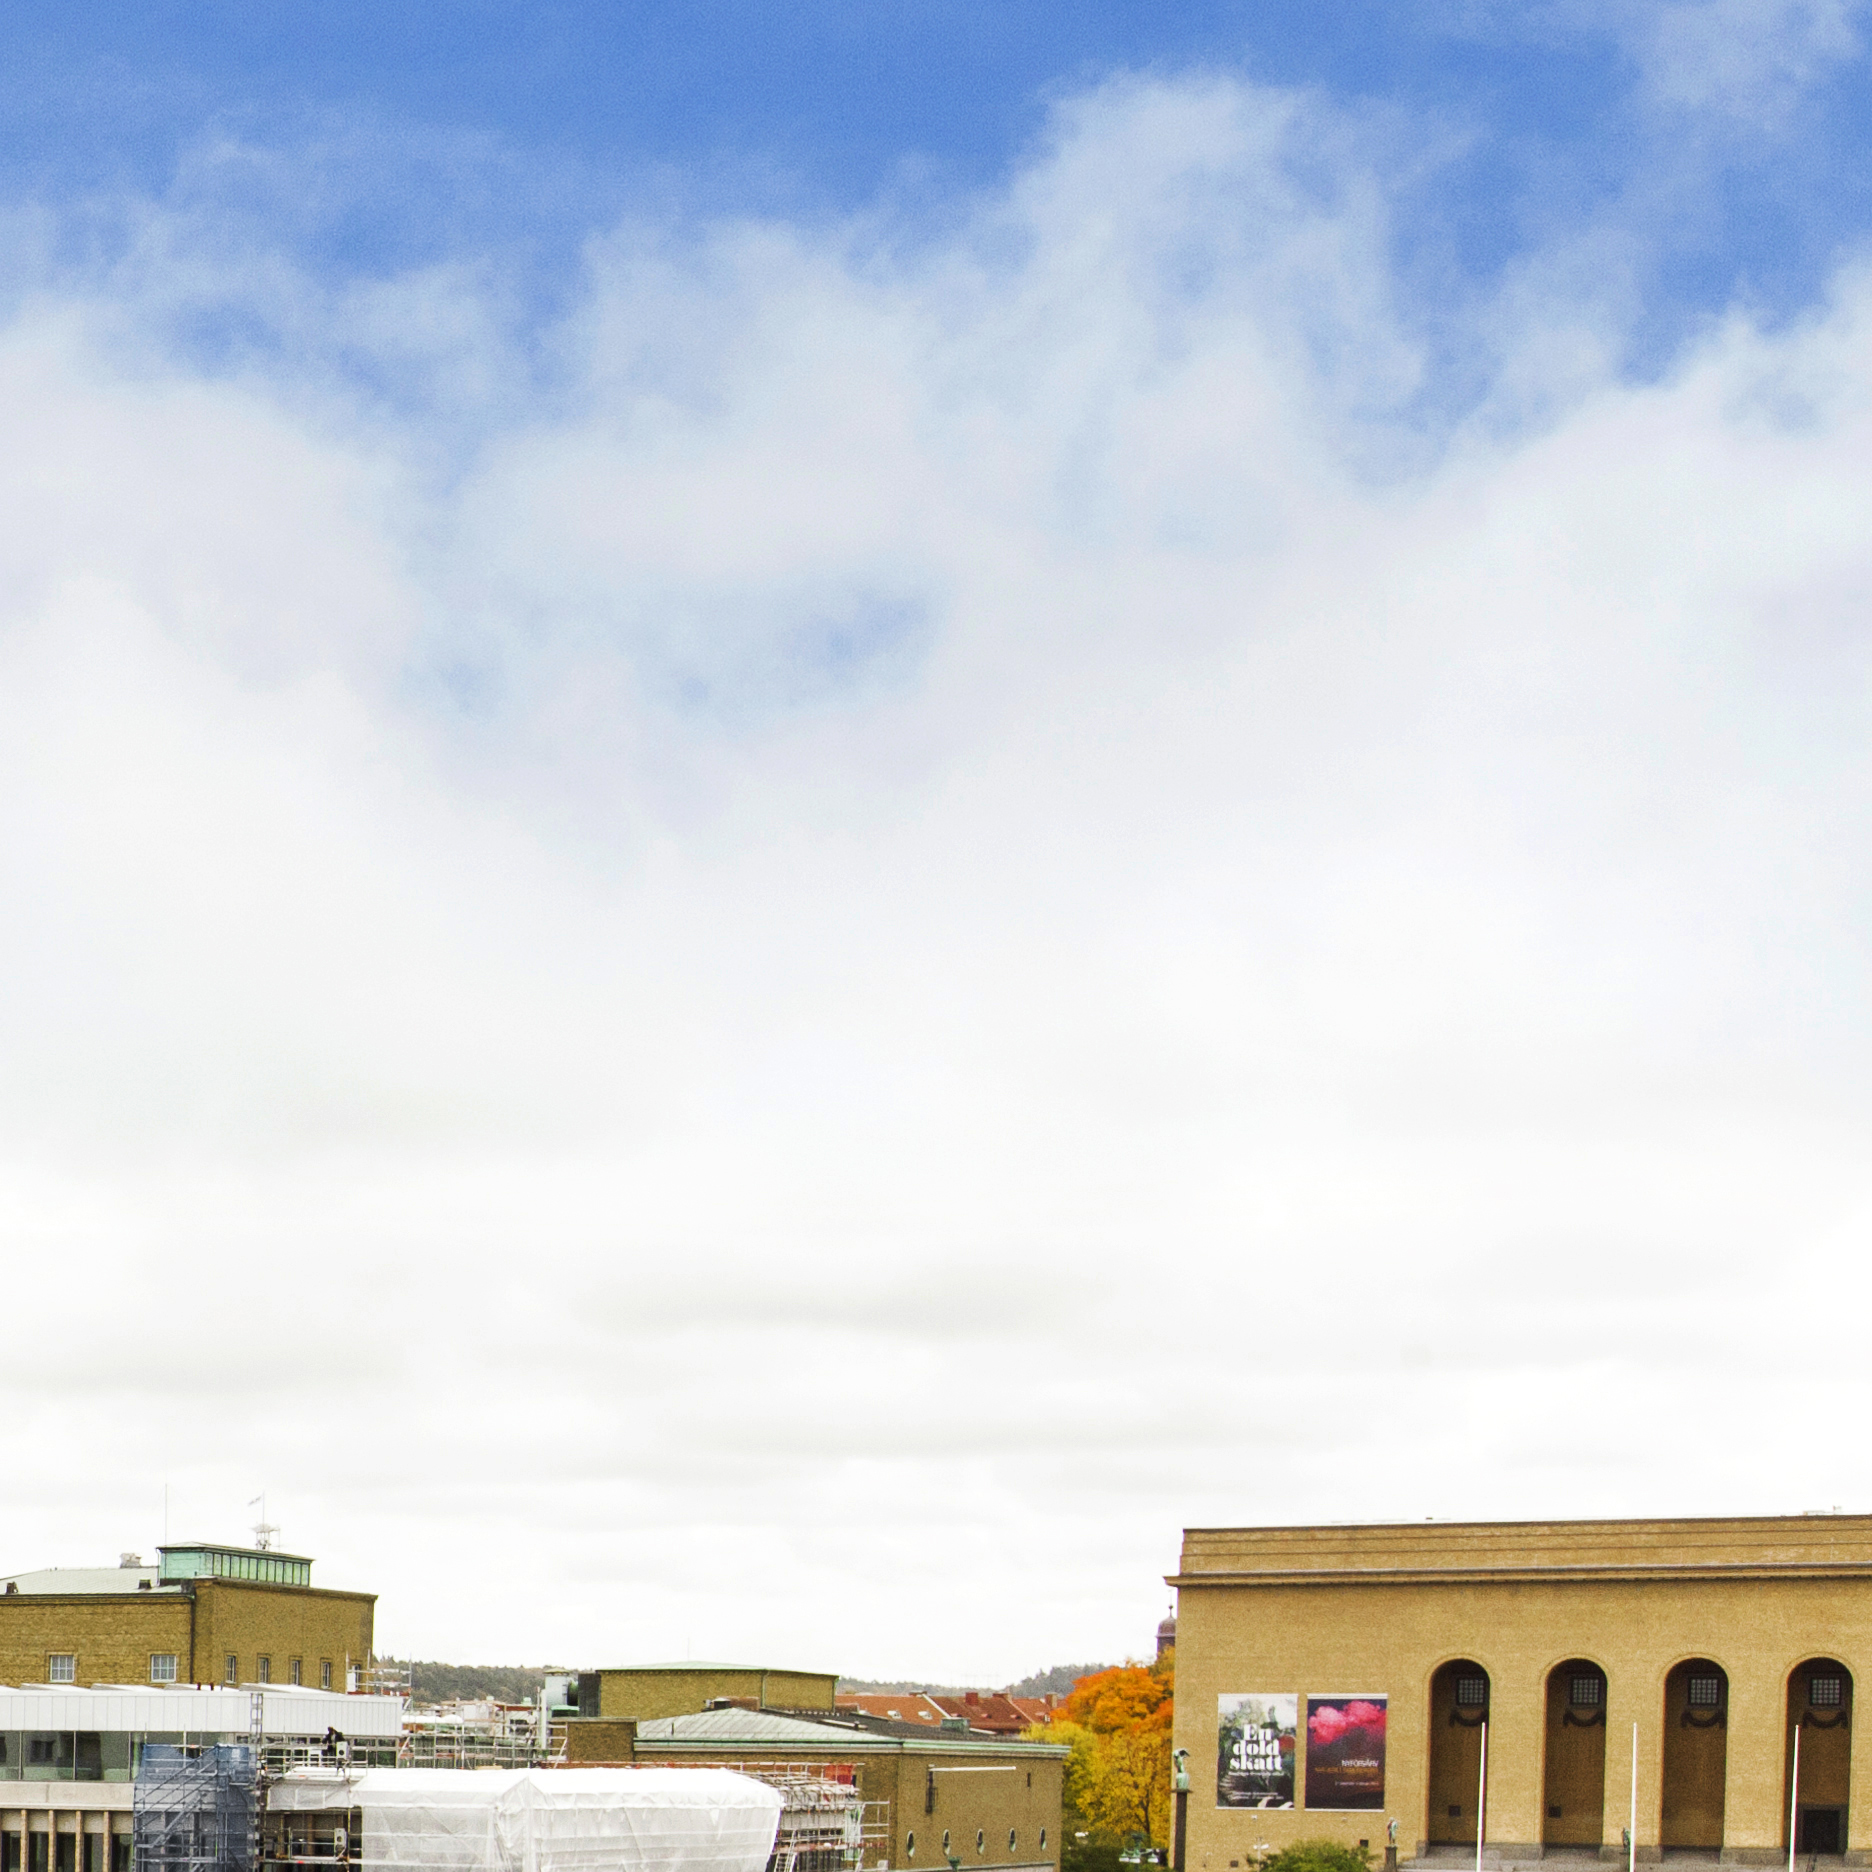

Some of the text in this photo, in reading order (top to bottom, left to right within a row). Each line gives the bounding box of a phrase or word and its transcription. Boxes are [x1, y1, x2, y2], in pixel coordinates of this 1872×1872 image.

[1243, 1724, 1273, 1740] En
[1232, 1739, 1280, 1755] dold
[1230, 1755, 1282, 1770] skatt
